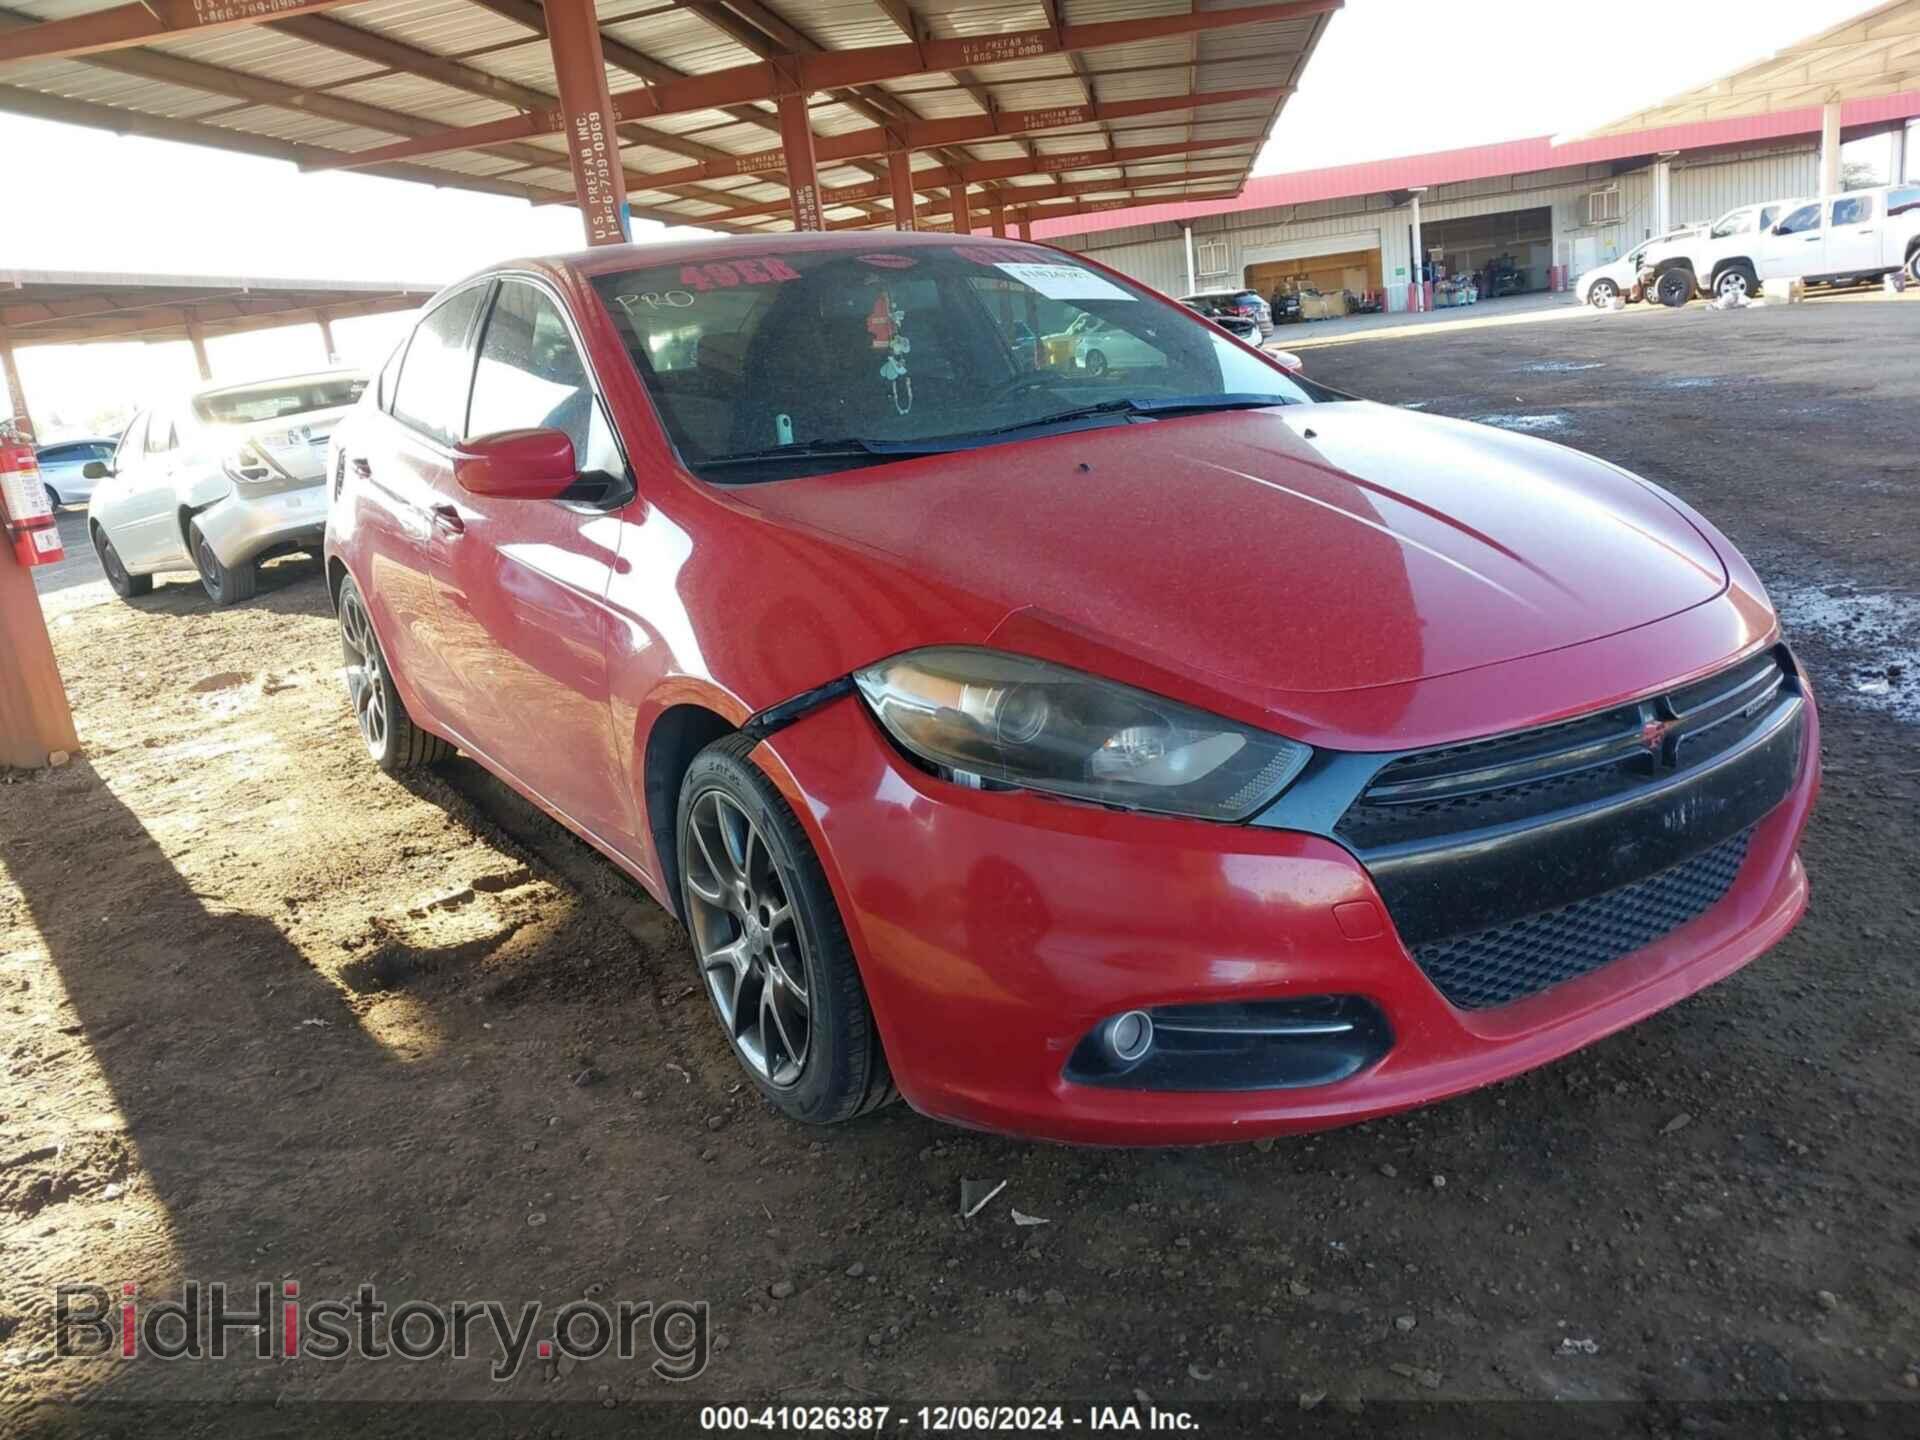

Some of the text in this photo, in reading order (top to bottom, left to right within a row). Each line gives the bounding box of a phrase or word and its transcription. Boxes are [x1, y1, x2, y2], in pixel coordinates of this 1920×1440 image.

[581, 147, 600, 205] PREFAB
[591, 211, 607, 240] U.S.
[614, 289, 695, 317] PRO
